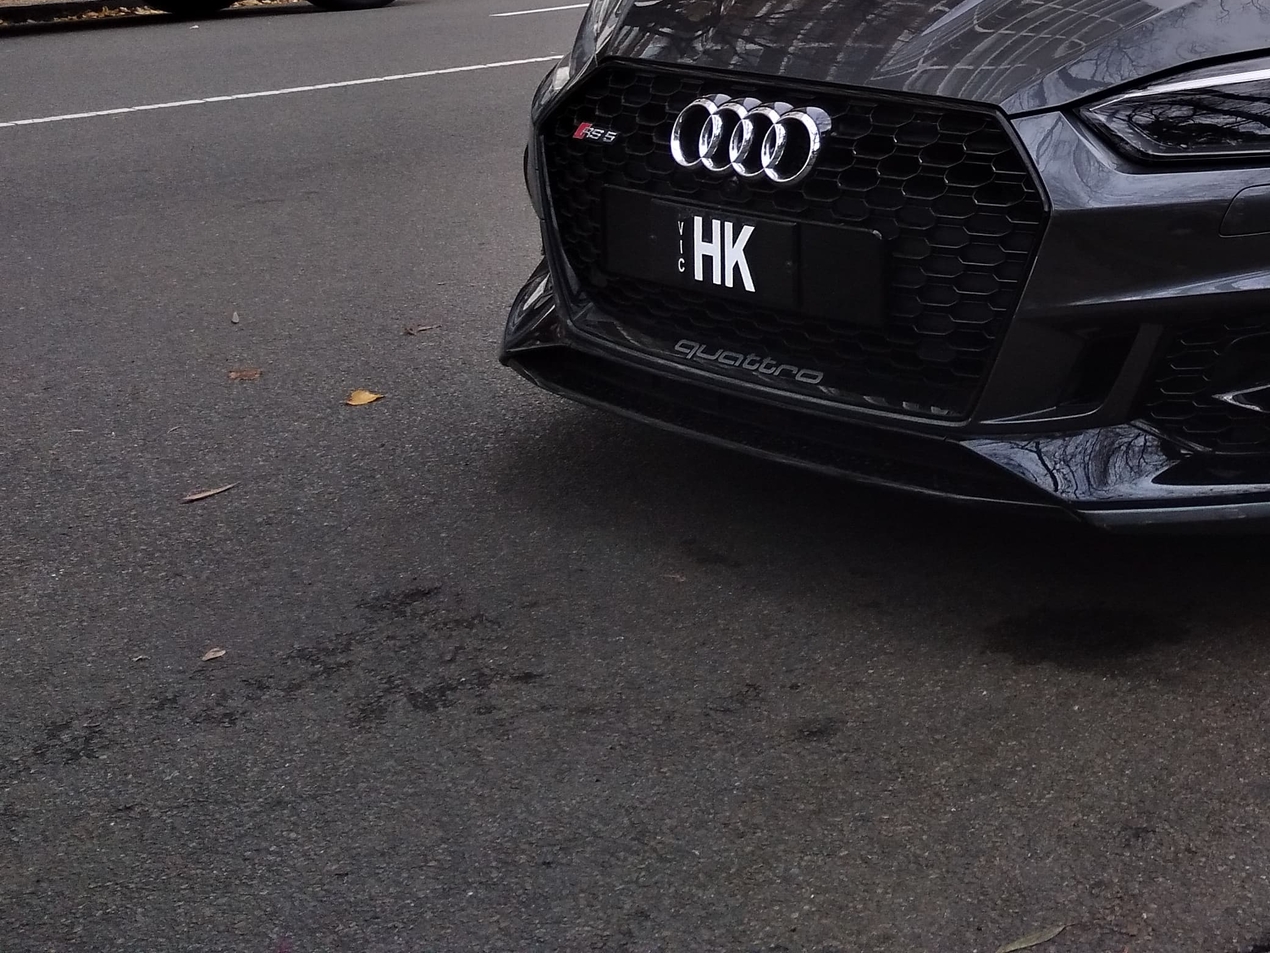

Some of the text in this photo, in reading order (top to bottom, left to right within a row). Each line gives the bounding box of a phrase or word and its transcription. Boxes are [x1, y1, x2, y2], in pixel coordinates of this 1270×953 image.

[677, 220, 685, 273] VIC
[694, 215, 756, 292] HK
[674, 338, 824, 384] quattro
